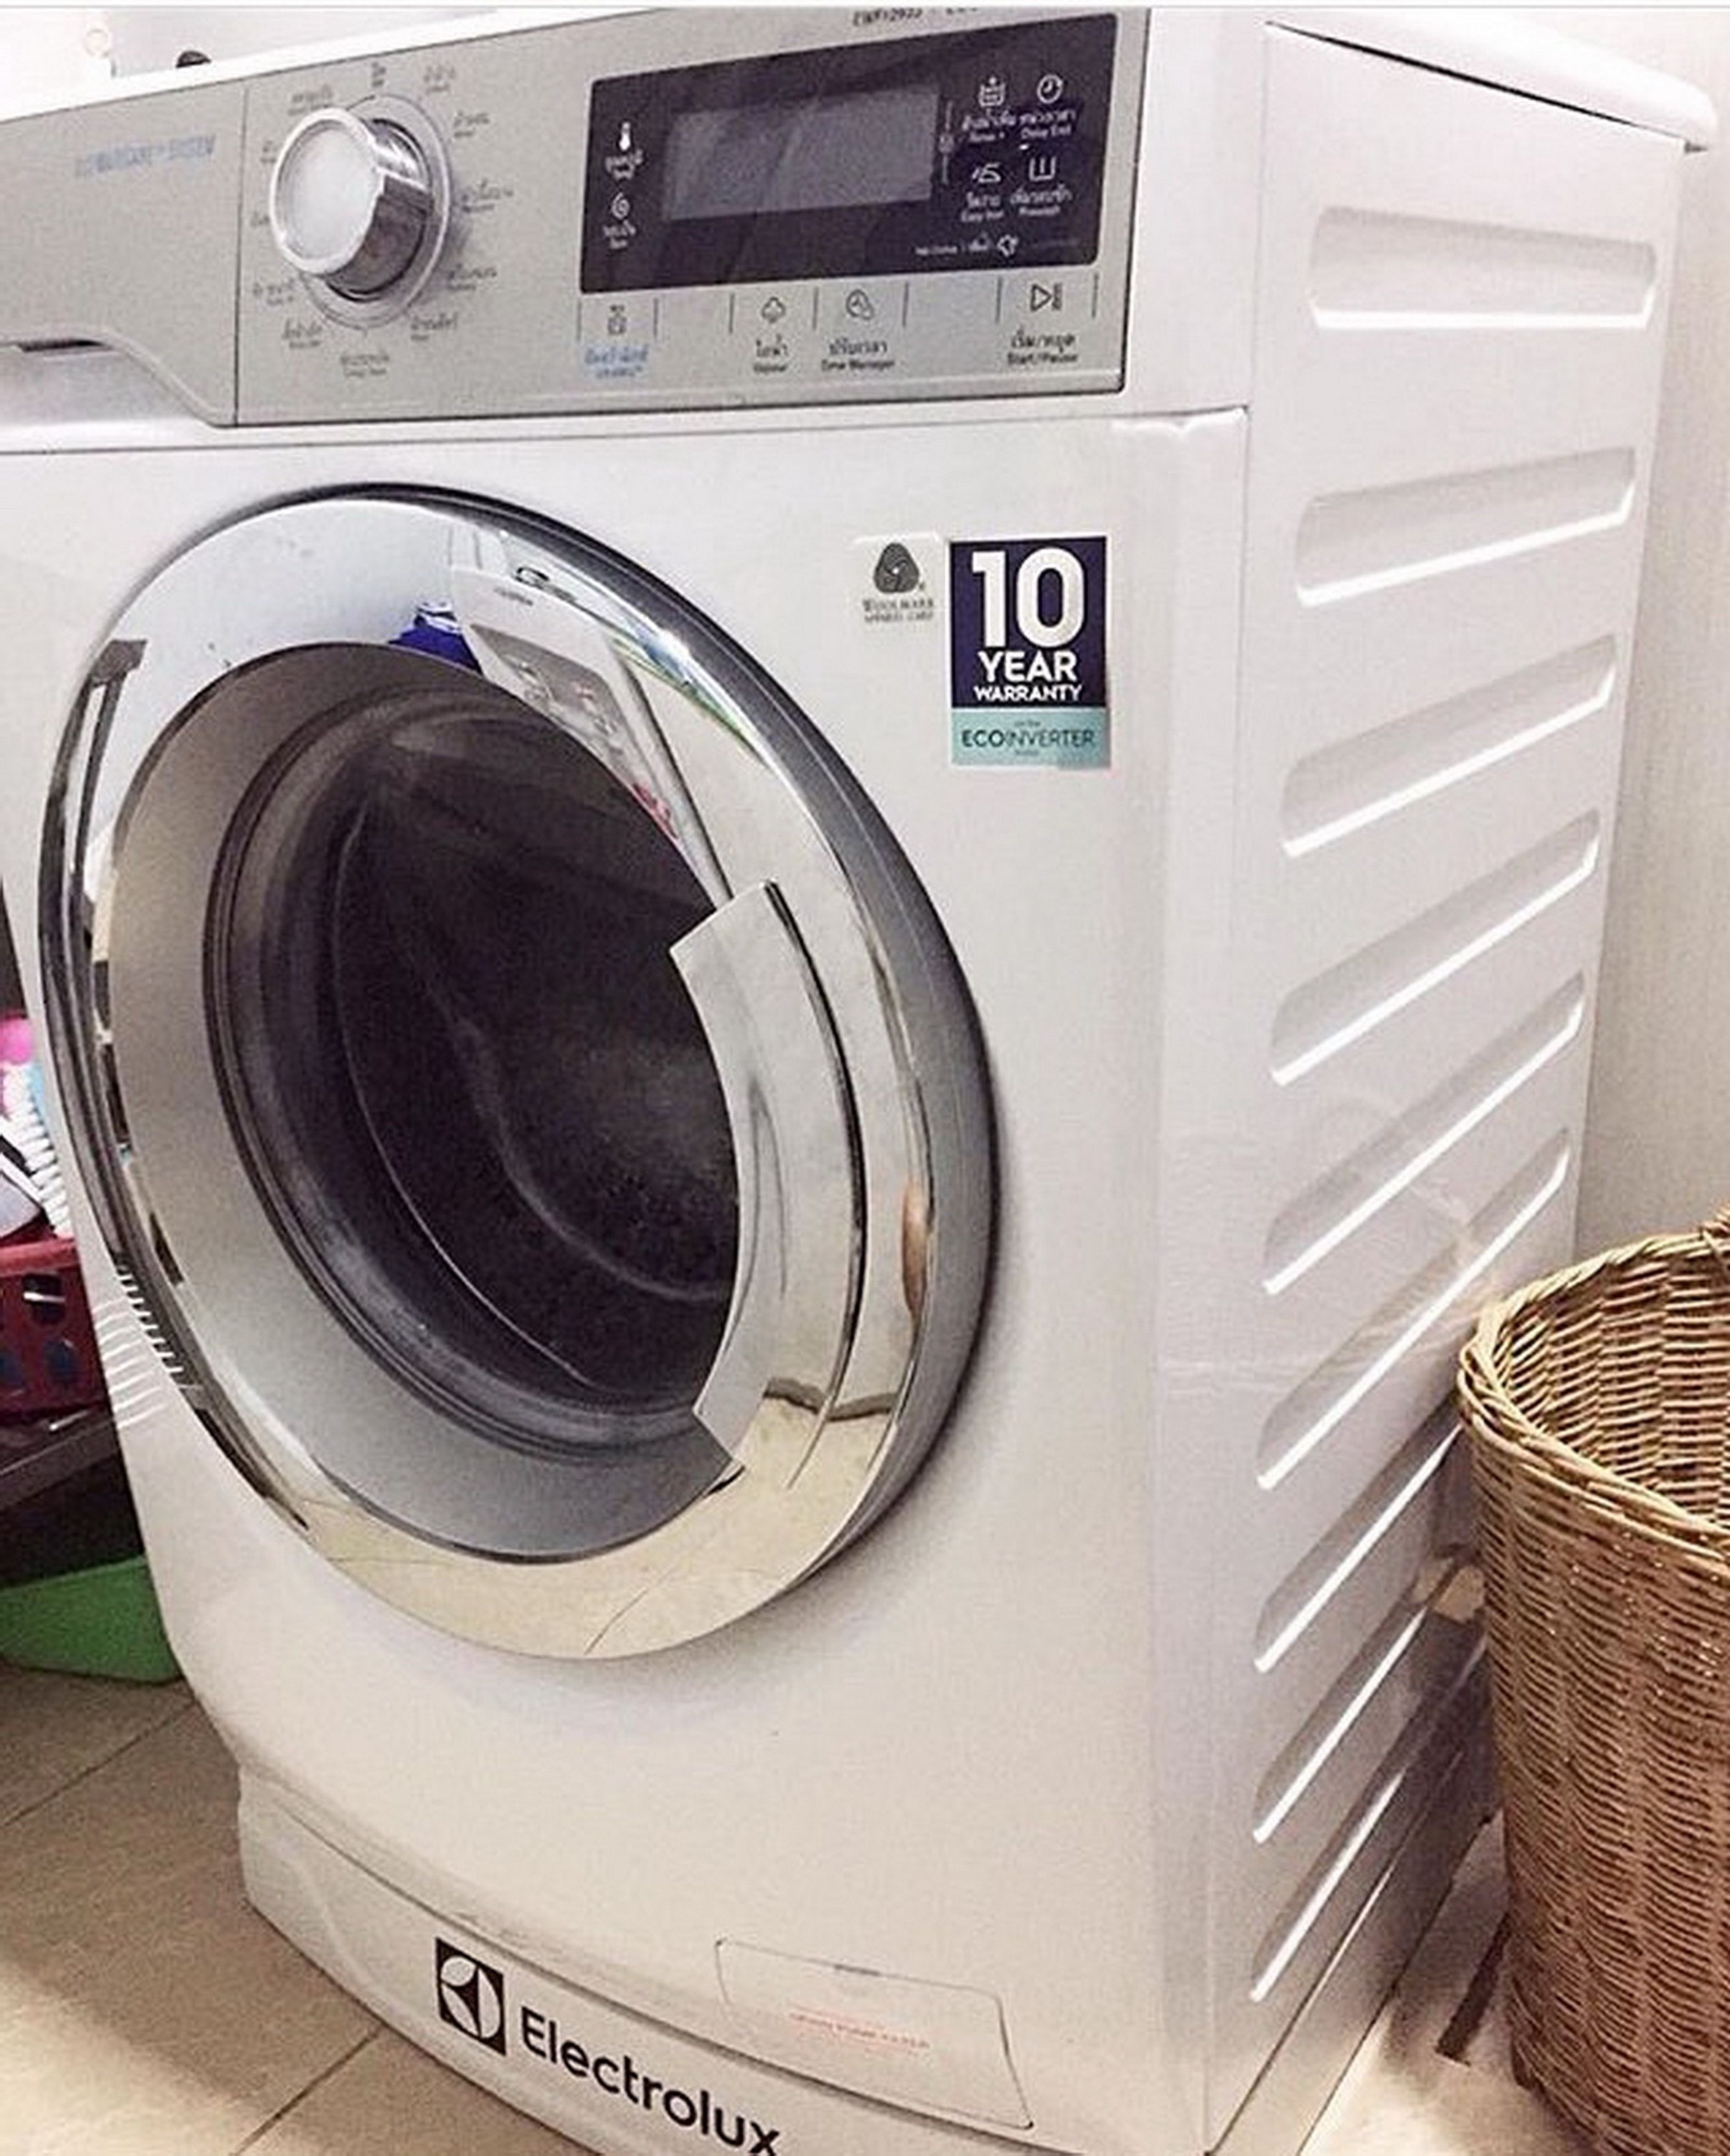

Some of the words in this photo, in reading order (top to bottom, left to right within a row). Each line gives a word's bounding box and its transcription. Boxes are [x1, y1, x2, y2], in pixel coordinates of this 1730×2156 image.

[972, 547, 1086, 648] 10
[978, 650, 1078, 683] YEAR
[973, 683, 1083, 702] WARRANTY
[962, 727, 1096, 748] ECOINVERTER
[520, 2005, 780, 2156] Electrolux
